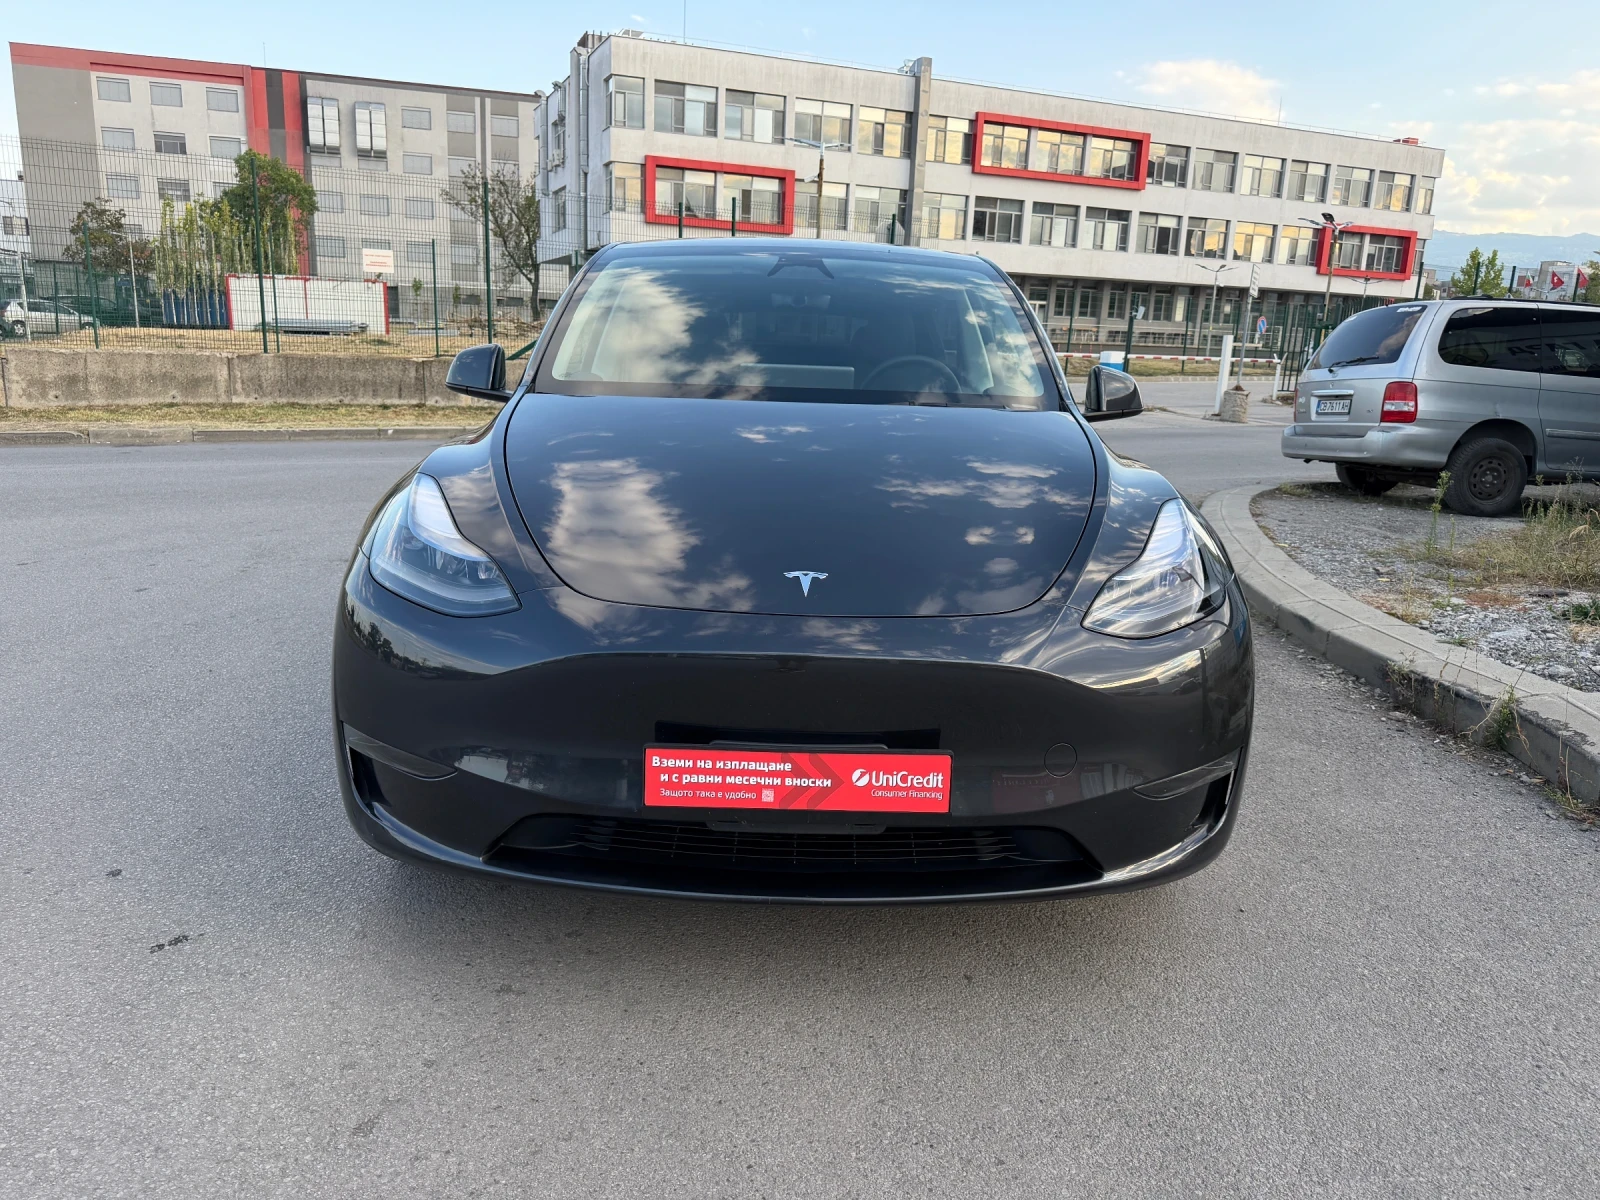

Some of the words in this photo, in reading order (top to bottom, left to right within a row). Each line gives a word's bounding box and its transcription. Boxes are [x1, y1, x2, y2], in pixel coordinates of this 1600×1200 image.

[651, 756, 693, 768] Вземи
[697, 758, 713, 769] на
[716, 759, 792, 773] изплащане
[660, 773, 669, 782] и
[672, 774, 679, 782] с
[682, 775, 723, 785] равни
[726, 775, 781, 786] месечни
[785, 777, 832, 787] вноски
[871, 770, 944, 788] UniCredit
[659, 788, 694, 799] Защото
[696, 789, 716, 798] така
[725, 790, 757, 800] удобно
[871, 789, 907, 798] Consumer
[909, 790, 943, 801] Financing
